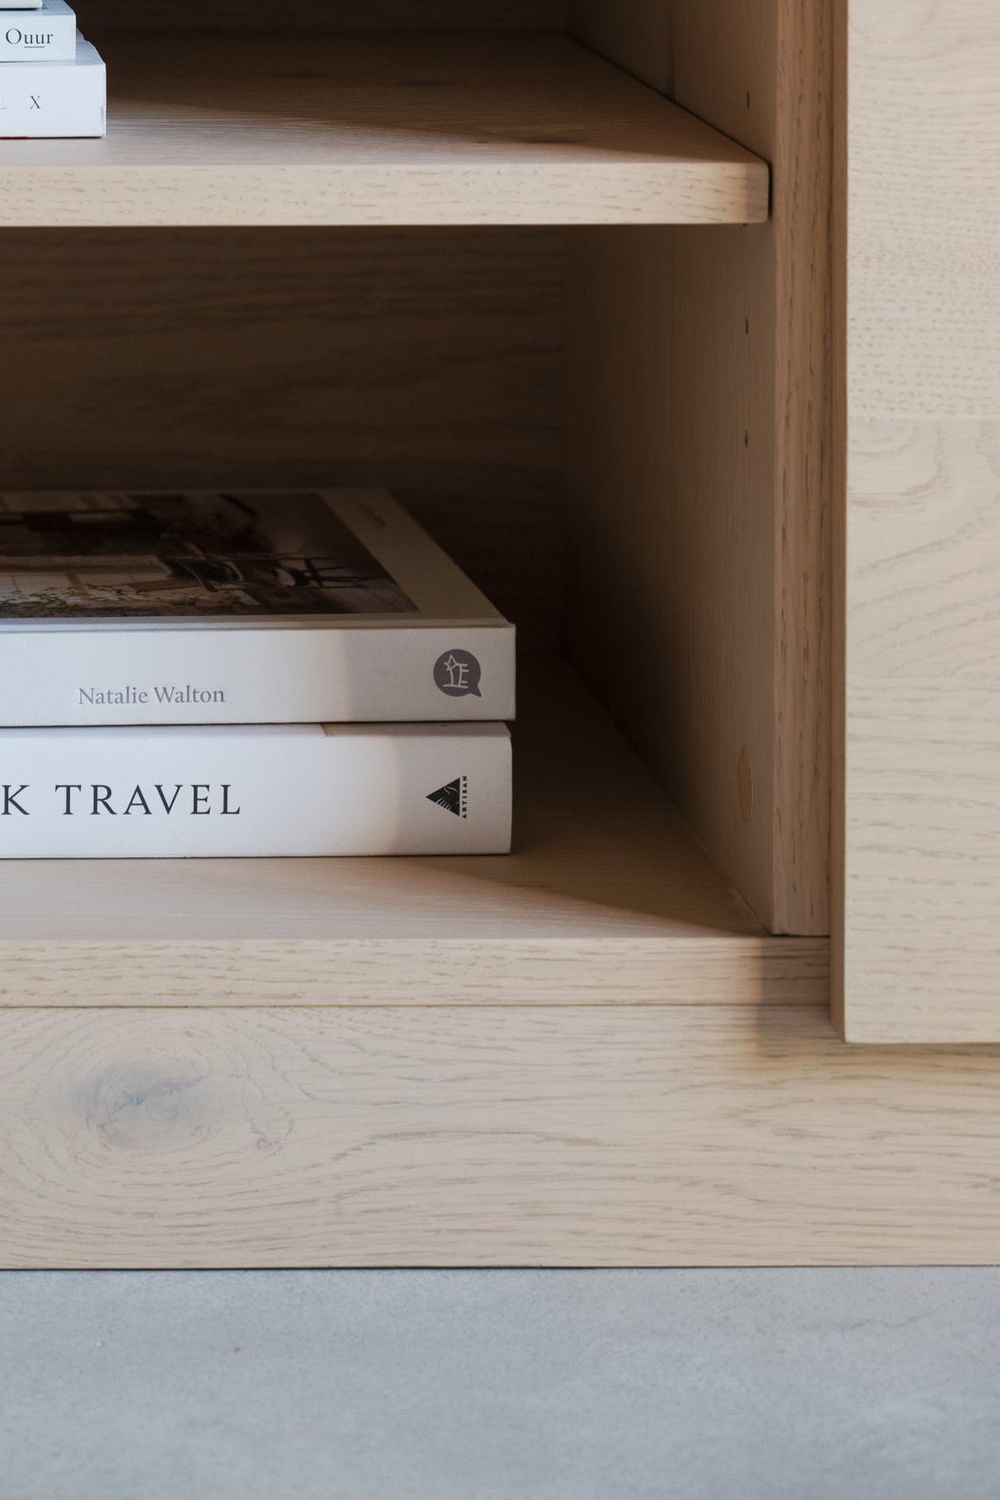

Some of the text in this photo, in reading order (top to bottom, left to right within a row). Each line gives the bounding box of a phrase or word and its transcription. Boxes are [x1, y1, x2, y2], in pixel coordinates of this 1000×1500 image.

[6, 29, 53, 48] Ouur
[30, 95, 41, 110] X
[77, 684, 226, 706] Natalie Walton
[55, 785, 240, 815] TRAVEL
